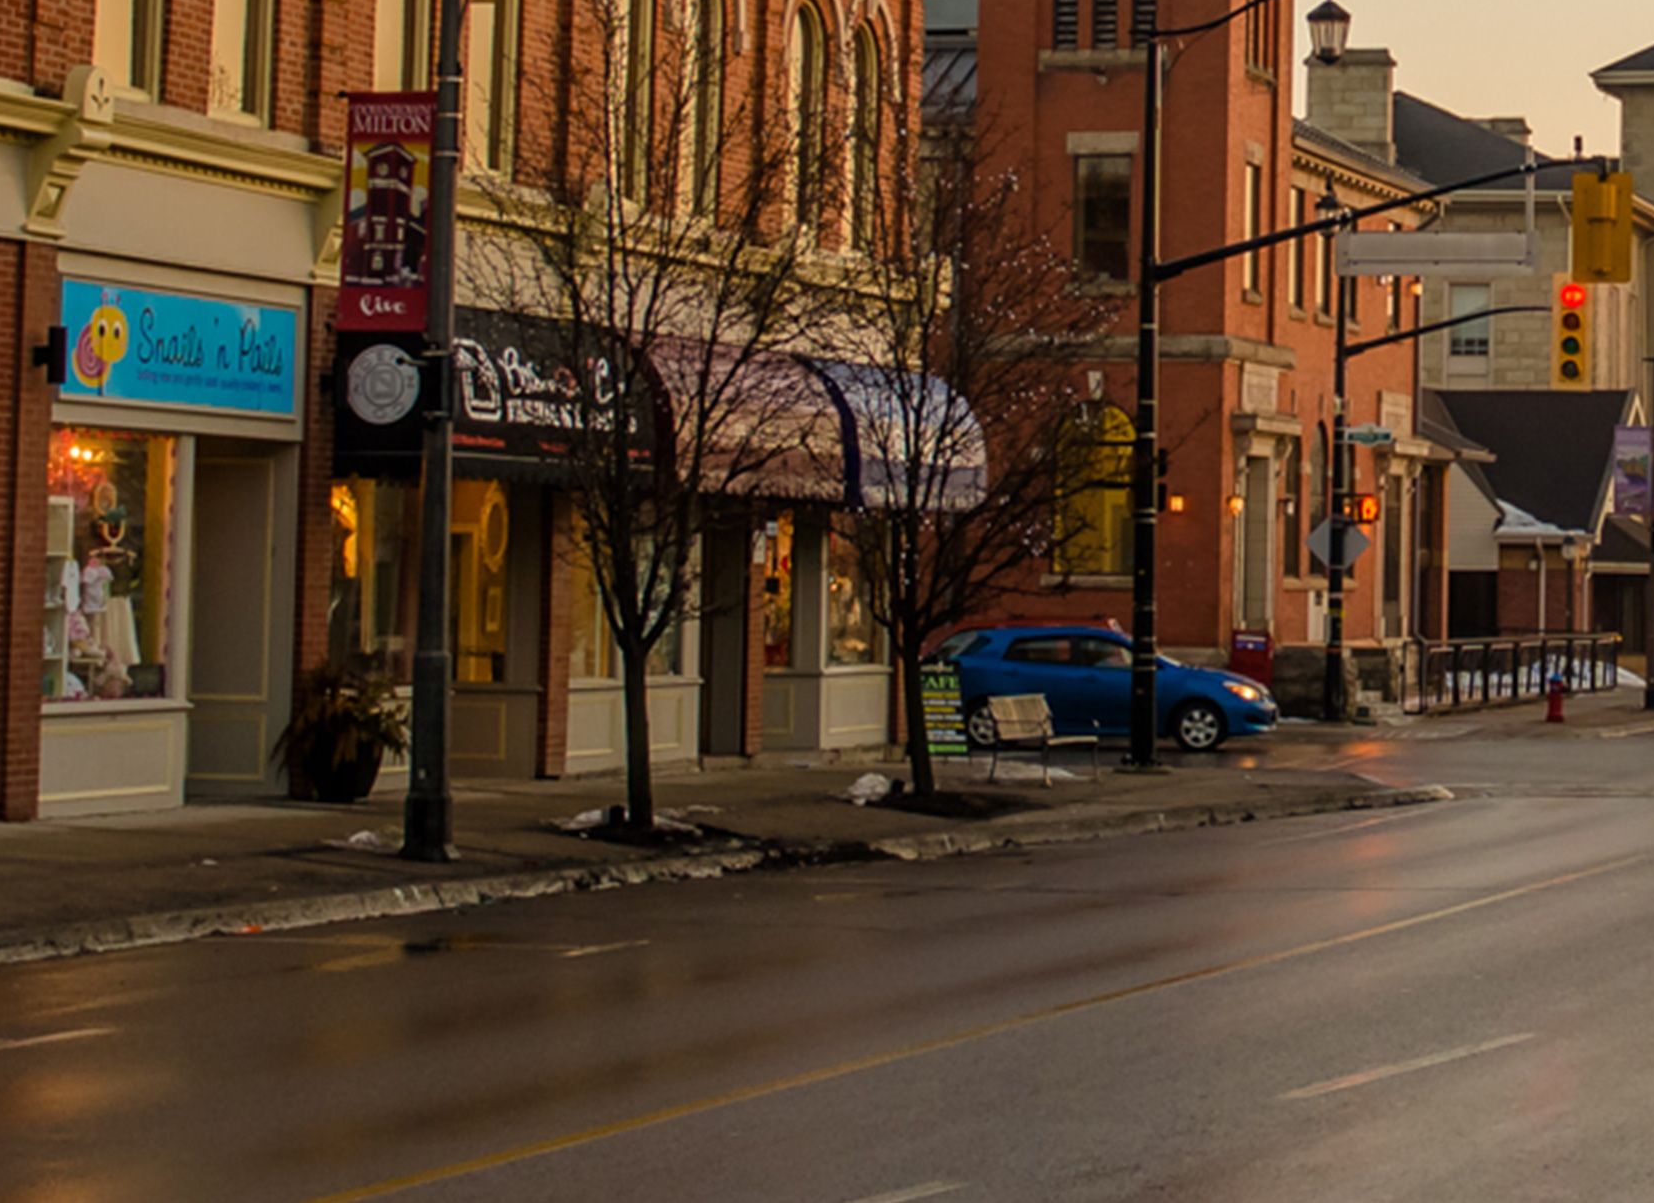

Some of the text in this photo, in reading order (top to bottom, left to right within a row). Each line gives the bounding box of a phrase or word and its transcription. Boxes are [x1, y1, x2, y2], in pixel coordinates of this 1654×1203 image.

[353, 114, 430, 134] MILTON
[359, 294, 407, 316] Live
[137, 307, 204, 368] Snails
[237, 318, 282, 376] Pails
[920, 675, 960, 690] AFE
